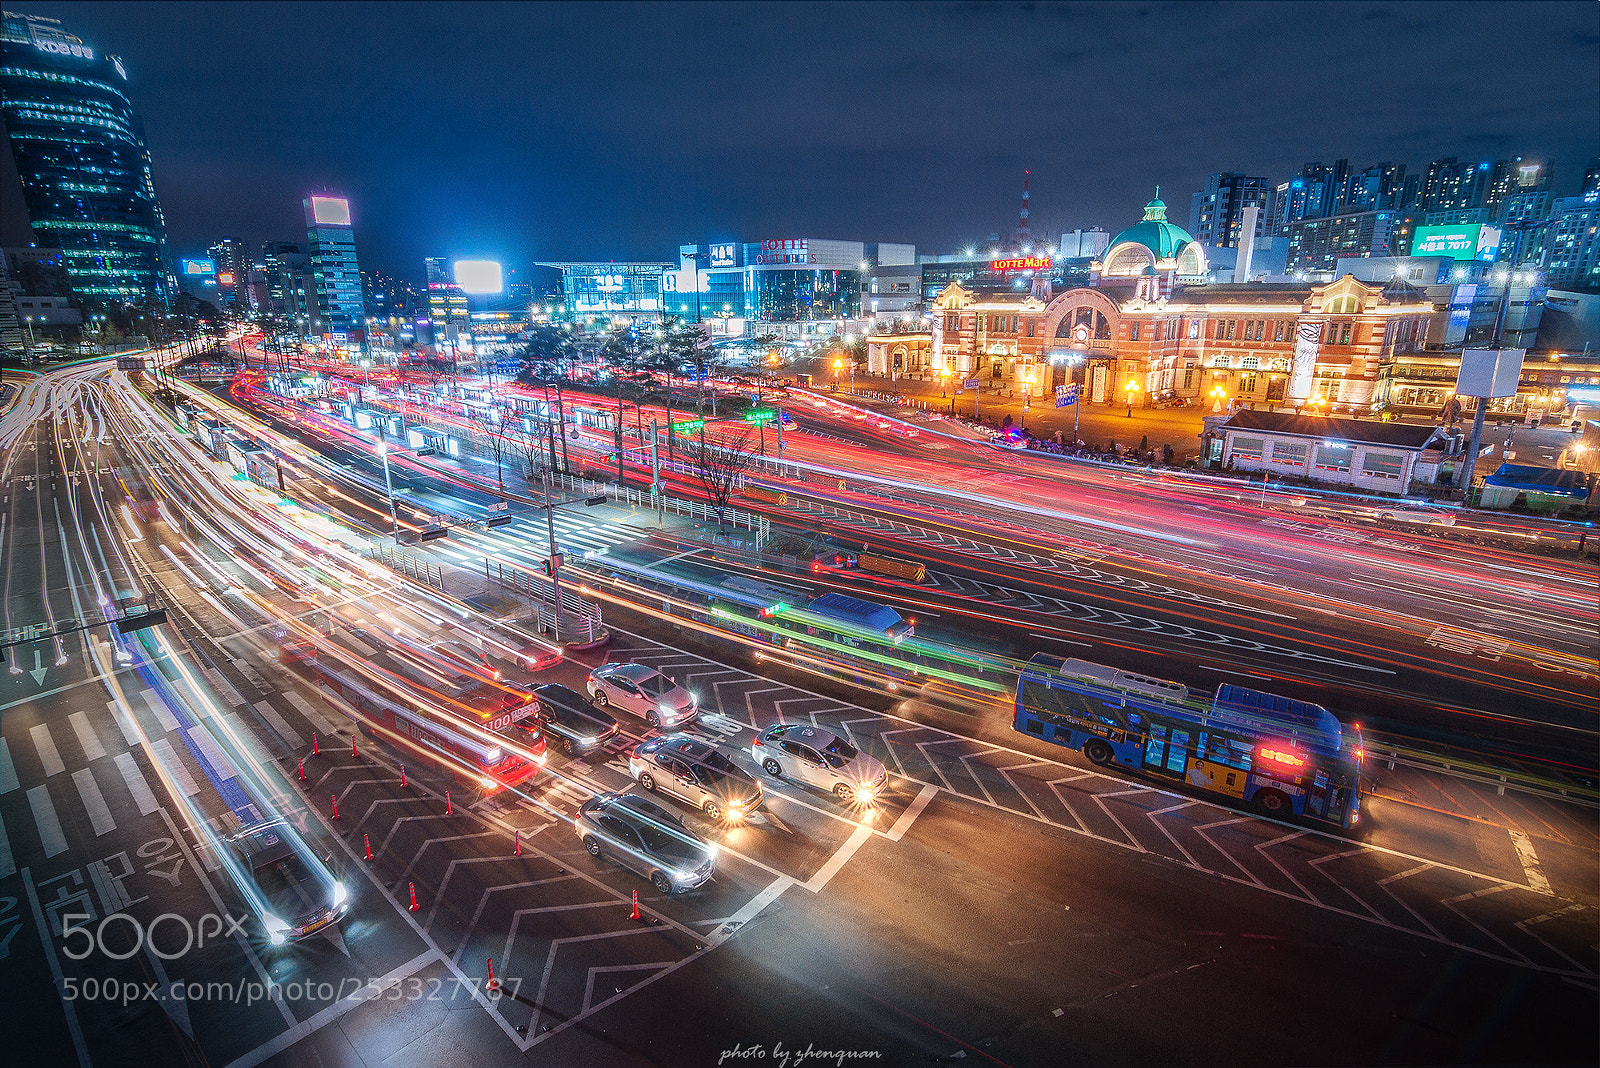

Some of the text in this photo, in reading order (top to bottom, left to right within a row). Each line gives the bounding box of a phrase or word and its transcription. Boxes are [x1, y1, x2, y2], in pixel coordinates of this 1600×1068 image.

[36, 39, 94, 60] KDB
[761, 238, 809, 250] LOTTE
[1417, 241, 1472, 252] 서울로 7017
[756, 253, 817, 264] OUTLETS
[38, 837, 185, 937] 숭례문
